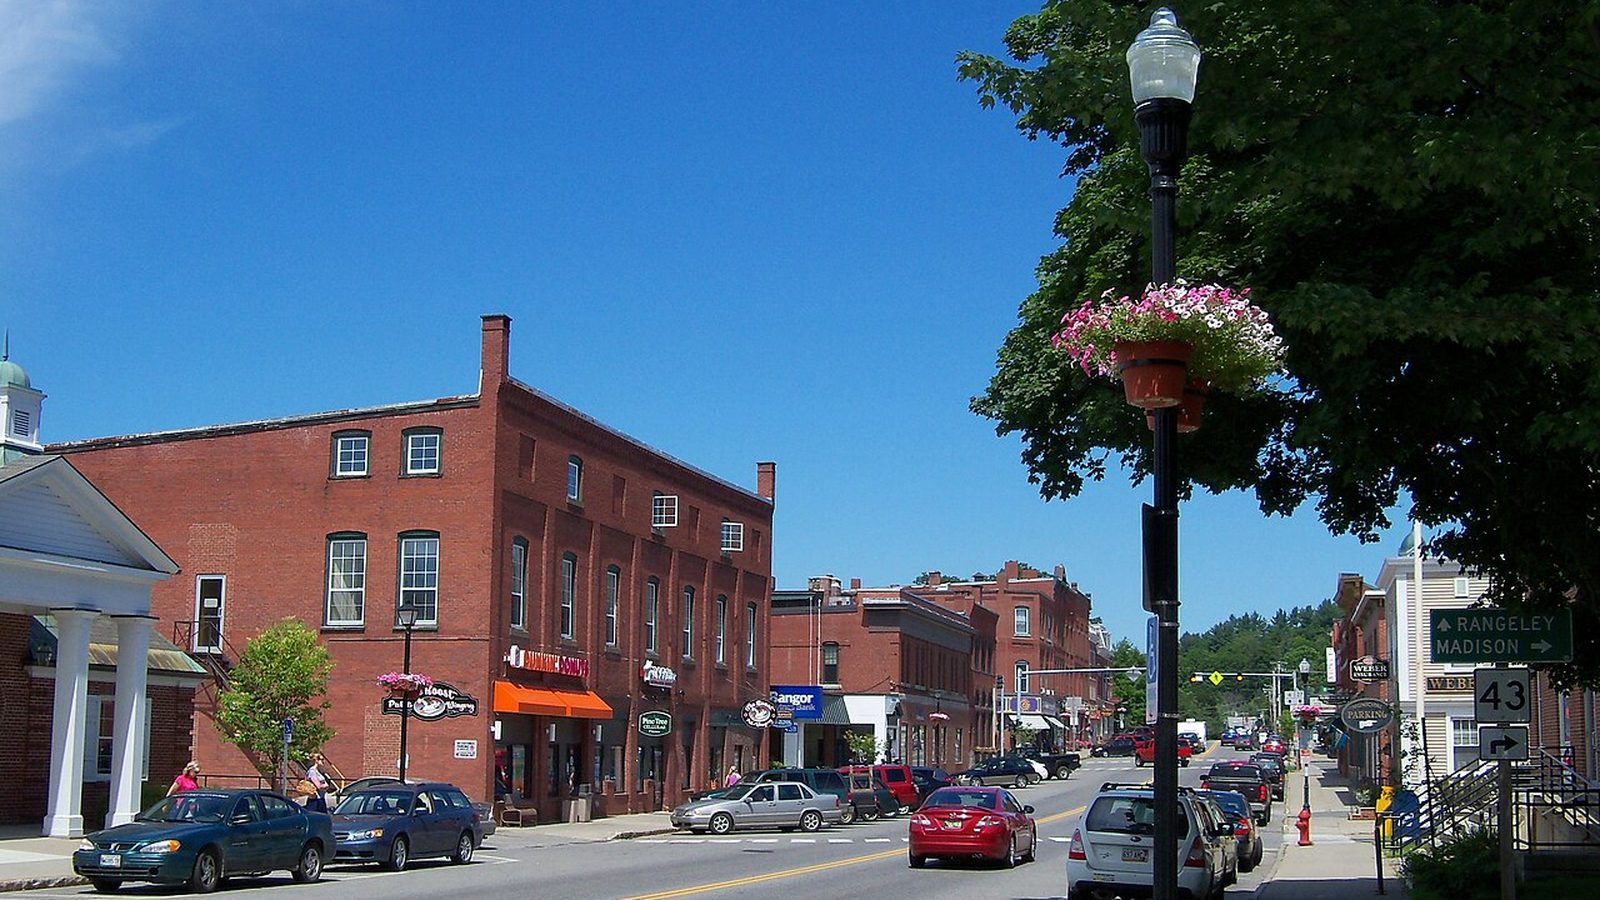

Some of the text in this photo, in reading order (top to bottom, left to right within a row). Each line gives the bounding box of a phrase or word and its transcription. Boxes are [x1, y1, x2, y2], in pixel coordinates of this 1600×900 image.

[1457, 616, 1555, 632] RANGELEY
[1436, 639, 1519, 654] MADISON
[770, 691, 815, 706] Bangor
[1479, 680, 1526, 711] 43
[642, 717, 655, 725] Pine
[1347, 710, 1388, 719] PARKING
